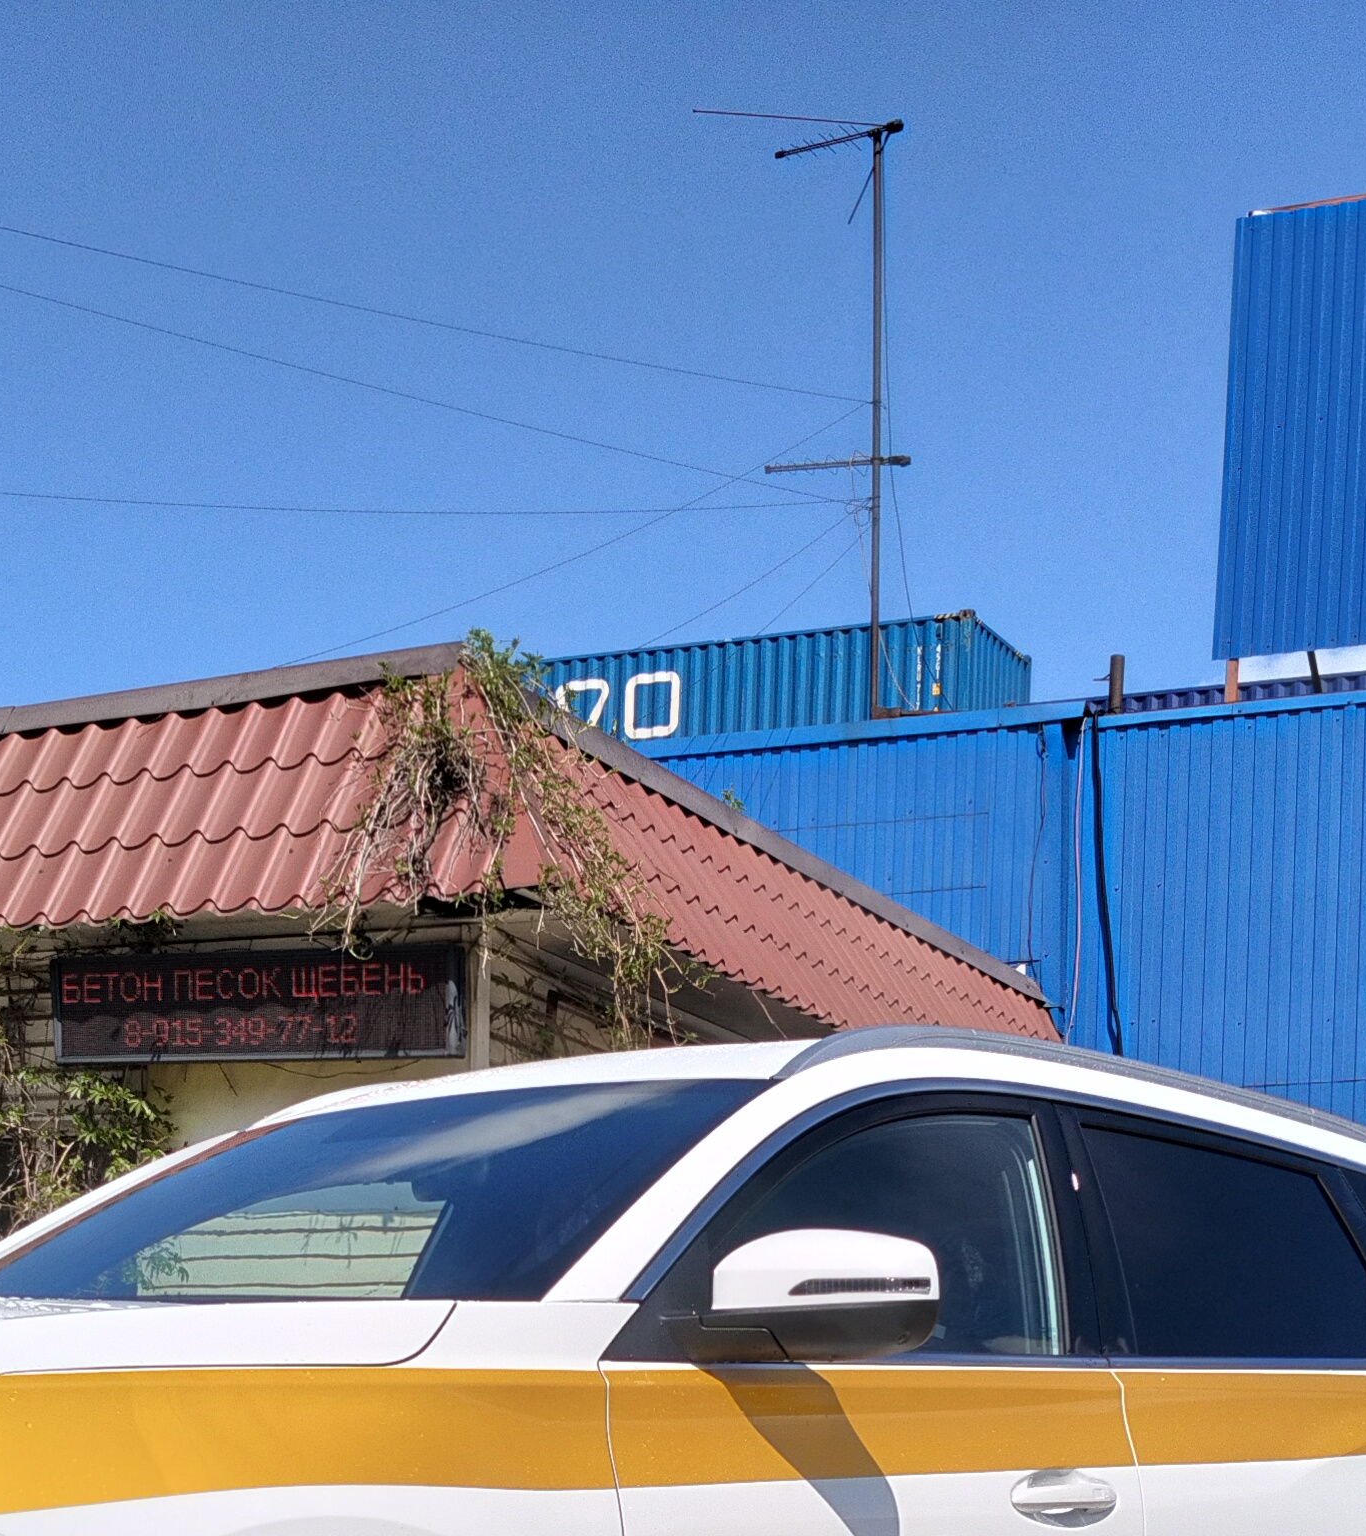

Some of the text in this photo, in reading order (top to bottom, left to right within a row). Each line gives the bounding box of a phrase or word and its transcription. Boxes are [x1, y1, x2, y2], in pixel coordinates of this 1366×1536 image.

[62, 963, 425, 1004] БЕТОН ПЕСОК ЩЕБЕНЬ
[124, 1014, 359, 1048] 8-915-349-77-12
